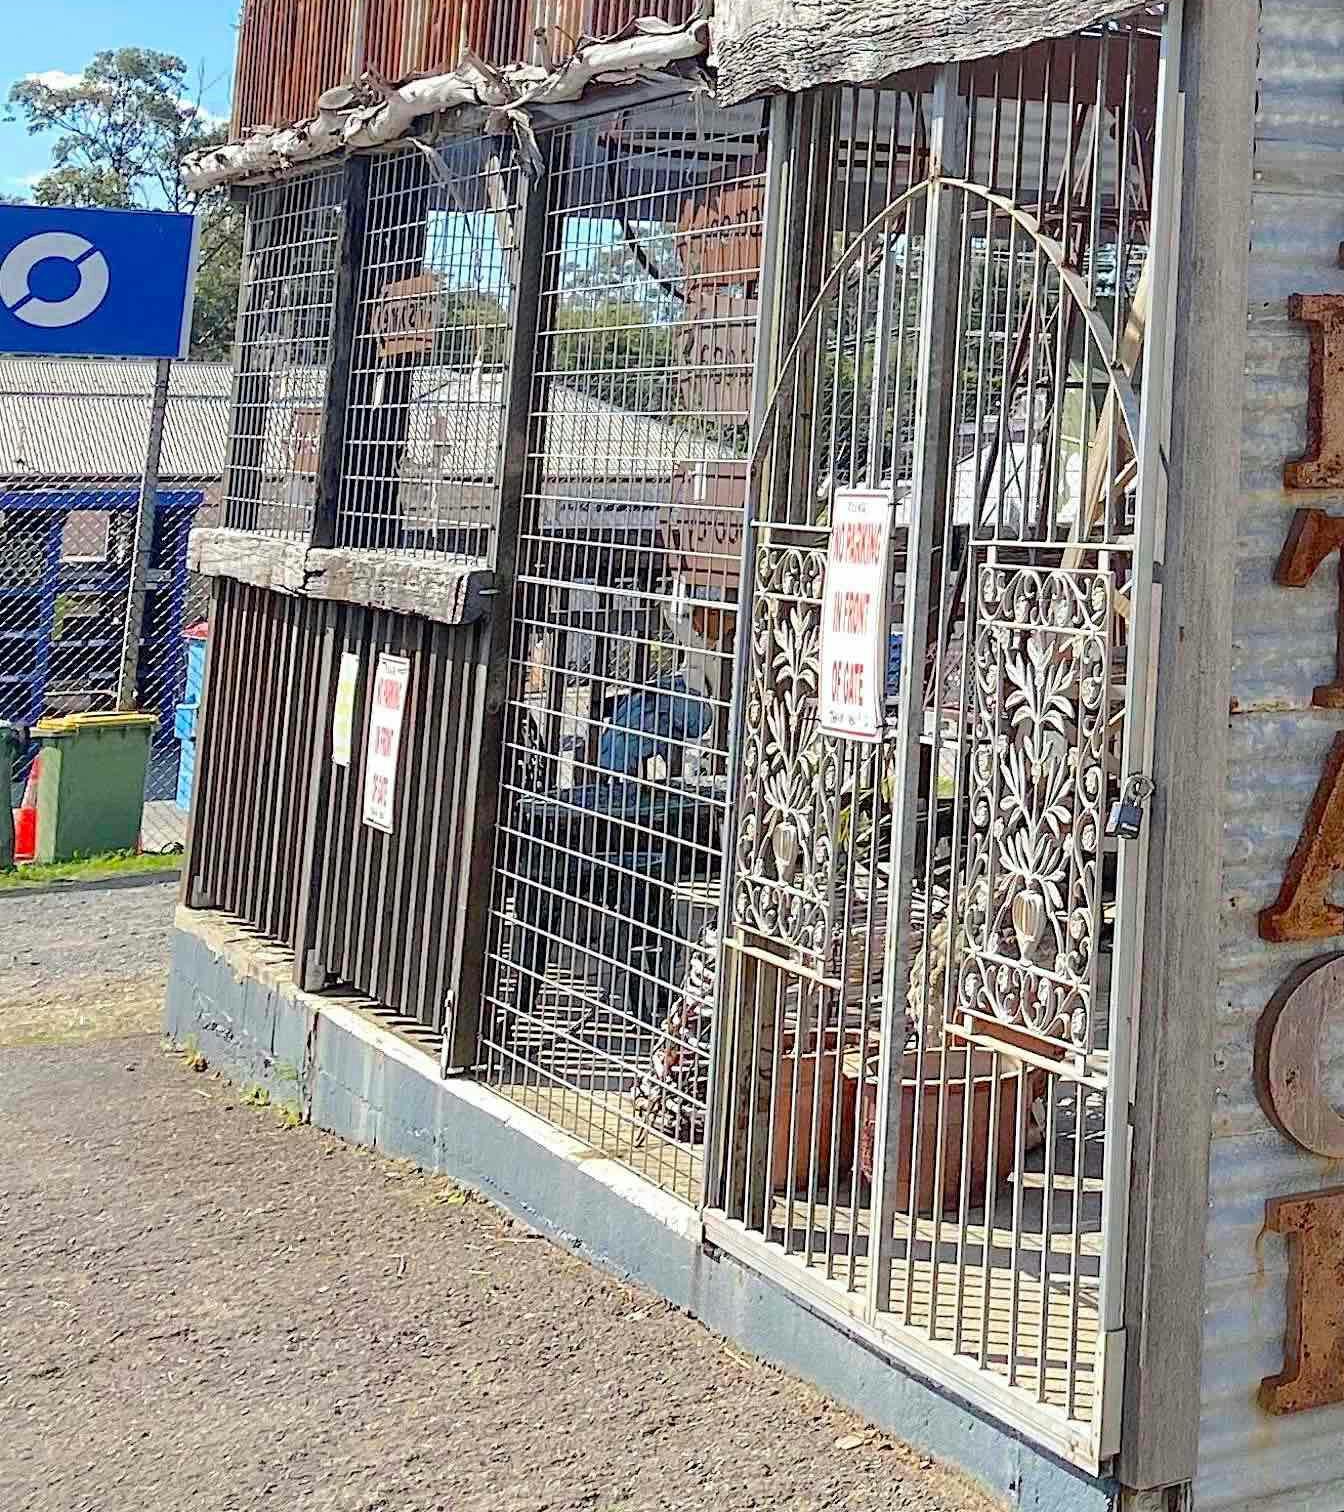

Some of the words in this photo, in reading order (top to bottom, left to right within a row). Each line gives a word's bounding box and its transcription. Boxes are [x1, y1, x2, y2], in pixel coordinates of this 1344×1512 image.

[845, 521, 882, 565] PARKING
[844, 591, 870, 635] FRONT
[843, 660, 864, 706] GATE
